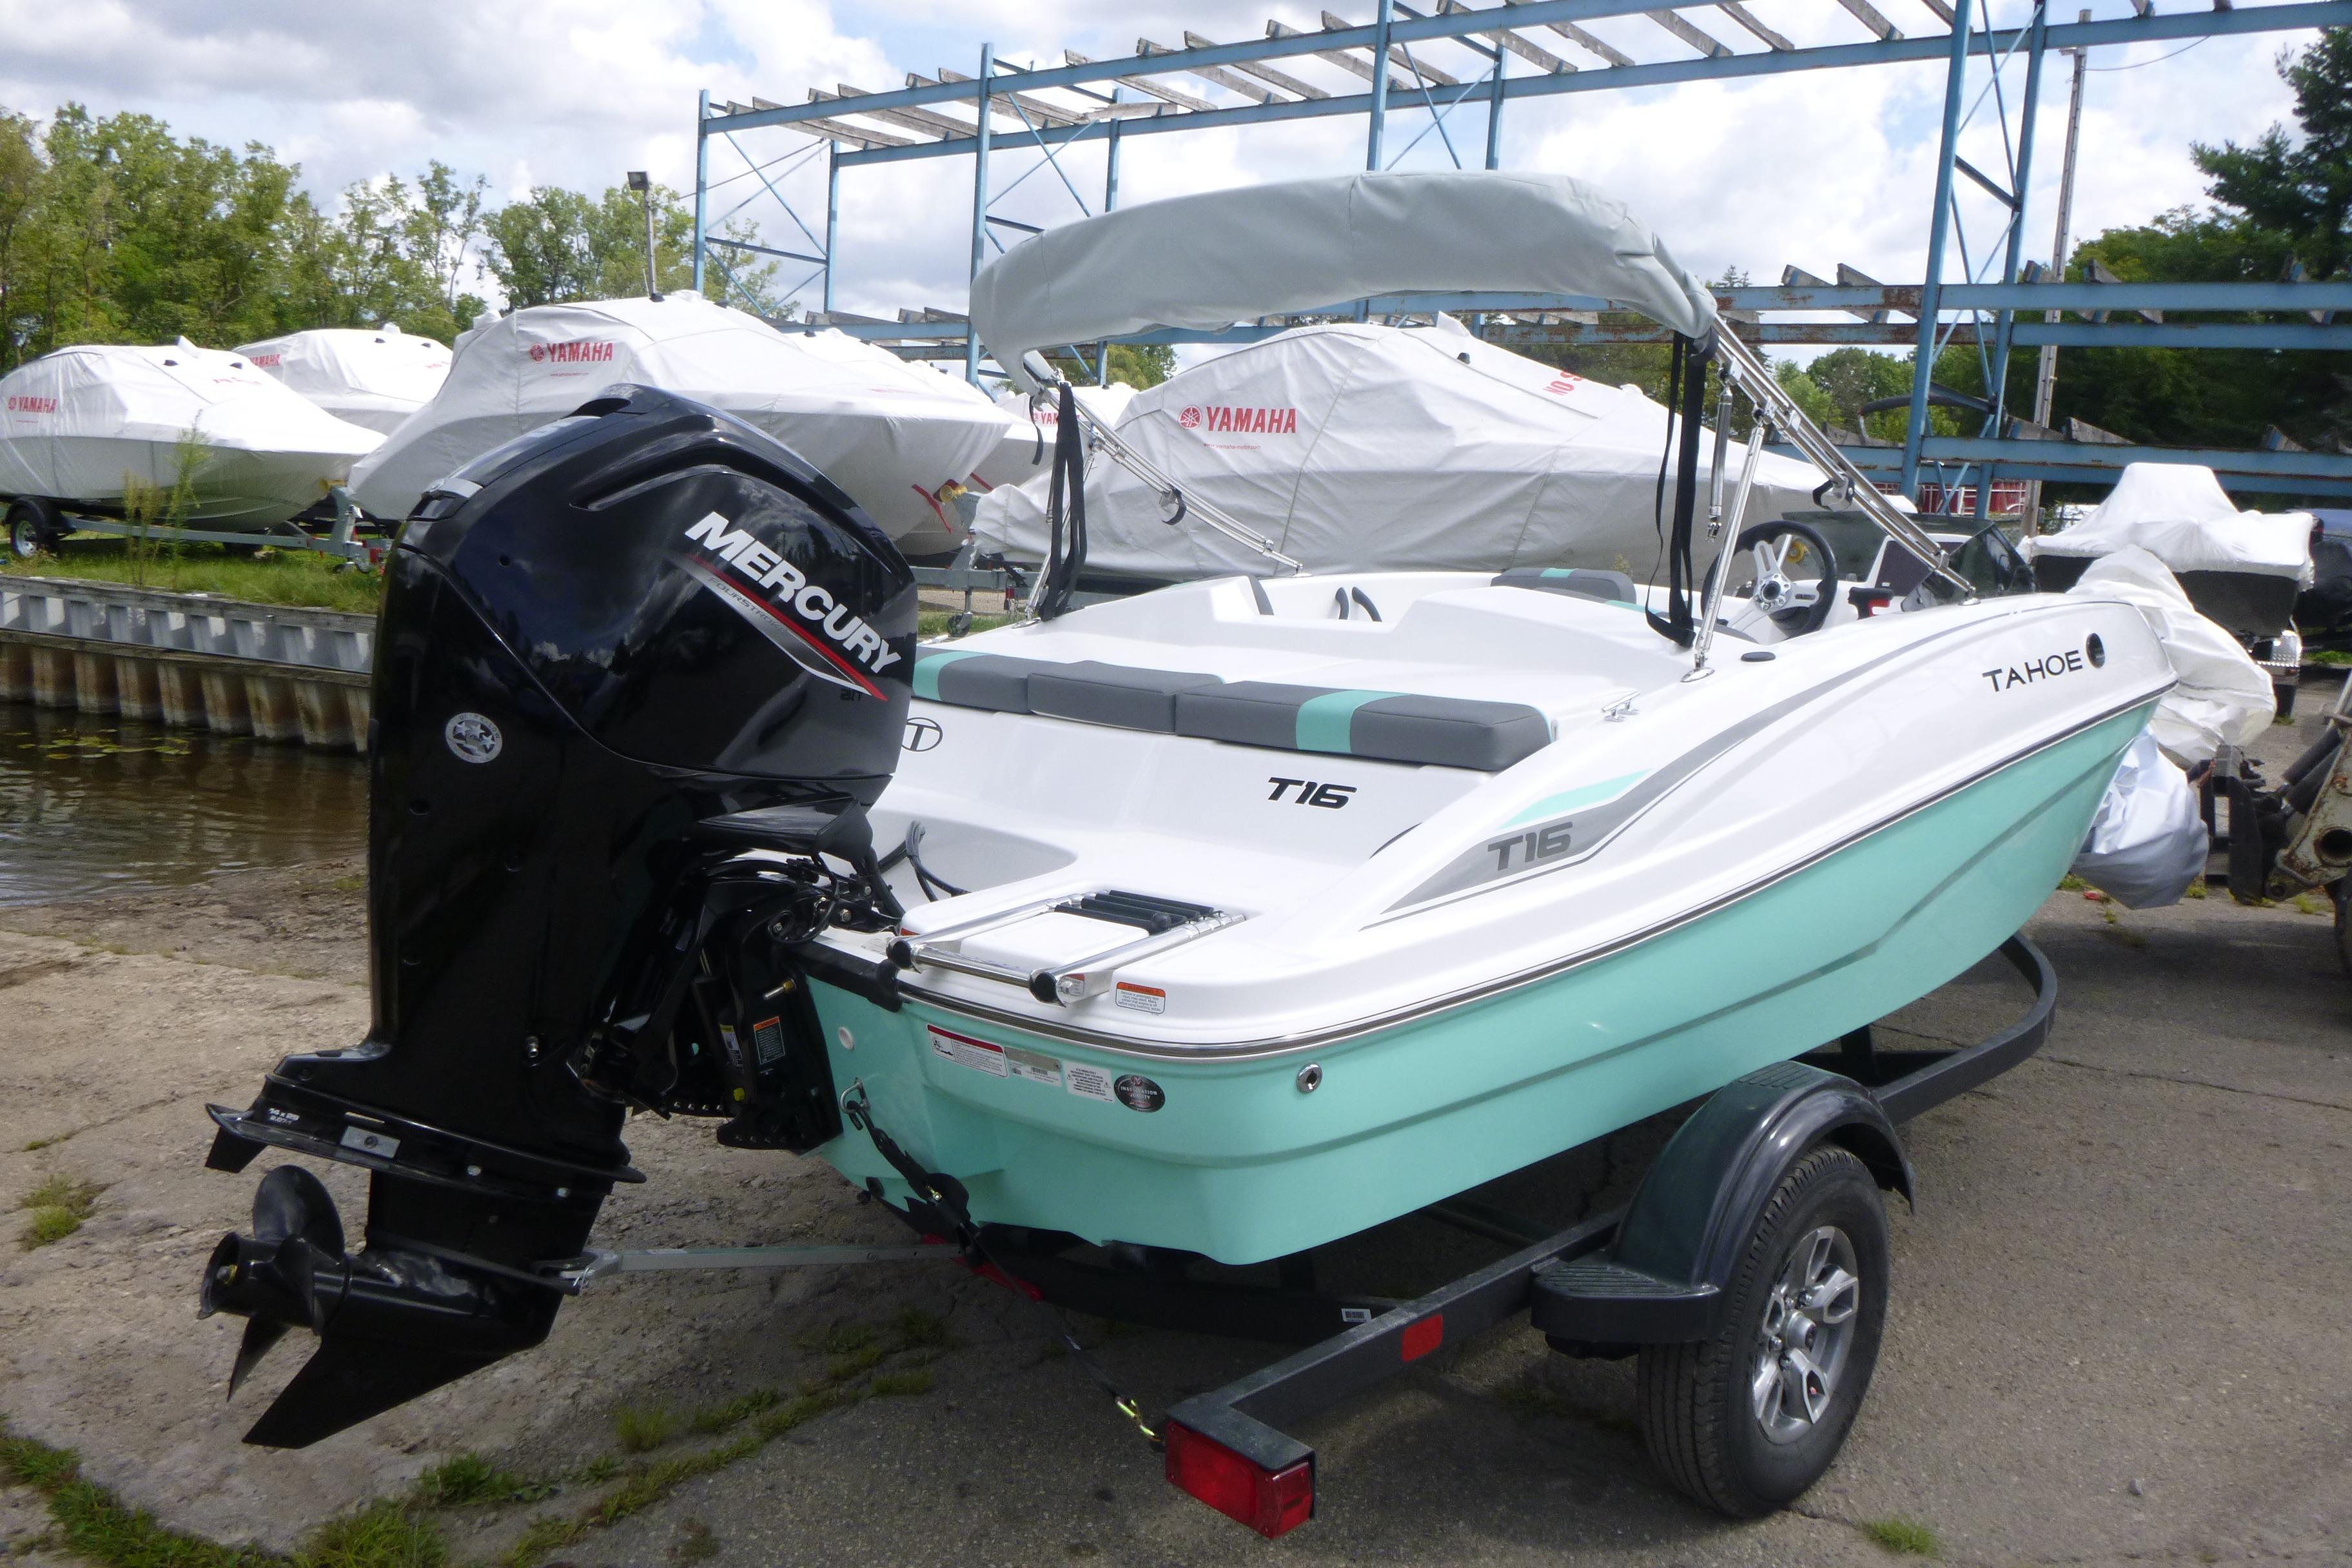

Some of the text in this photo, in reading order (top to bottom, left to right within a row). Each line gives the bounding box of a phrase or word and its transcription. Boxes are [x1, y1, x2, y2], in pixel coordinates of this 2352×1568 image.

[546, 342, 612, 362] YAMAHA
[19, 397, 57, 413] YAMAHA
[1206, 406, 1296, 434] YAMAHA
[685, 511, 901, 674] MERCURY
[1982, 650, 2083, 692] TAHOE
[1268, 776, 1357, 810] T16
[1487, 821, 1573, 871] T16
[1121, 1086, 1158, 1095] INSTATION
